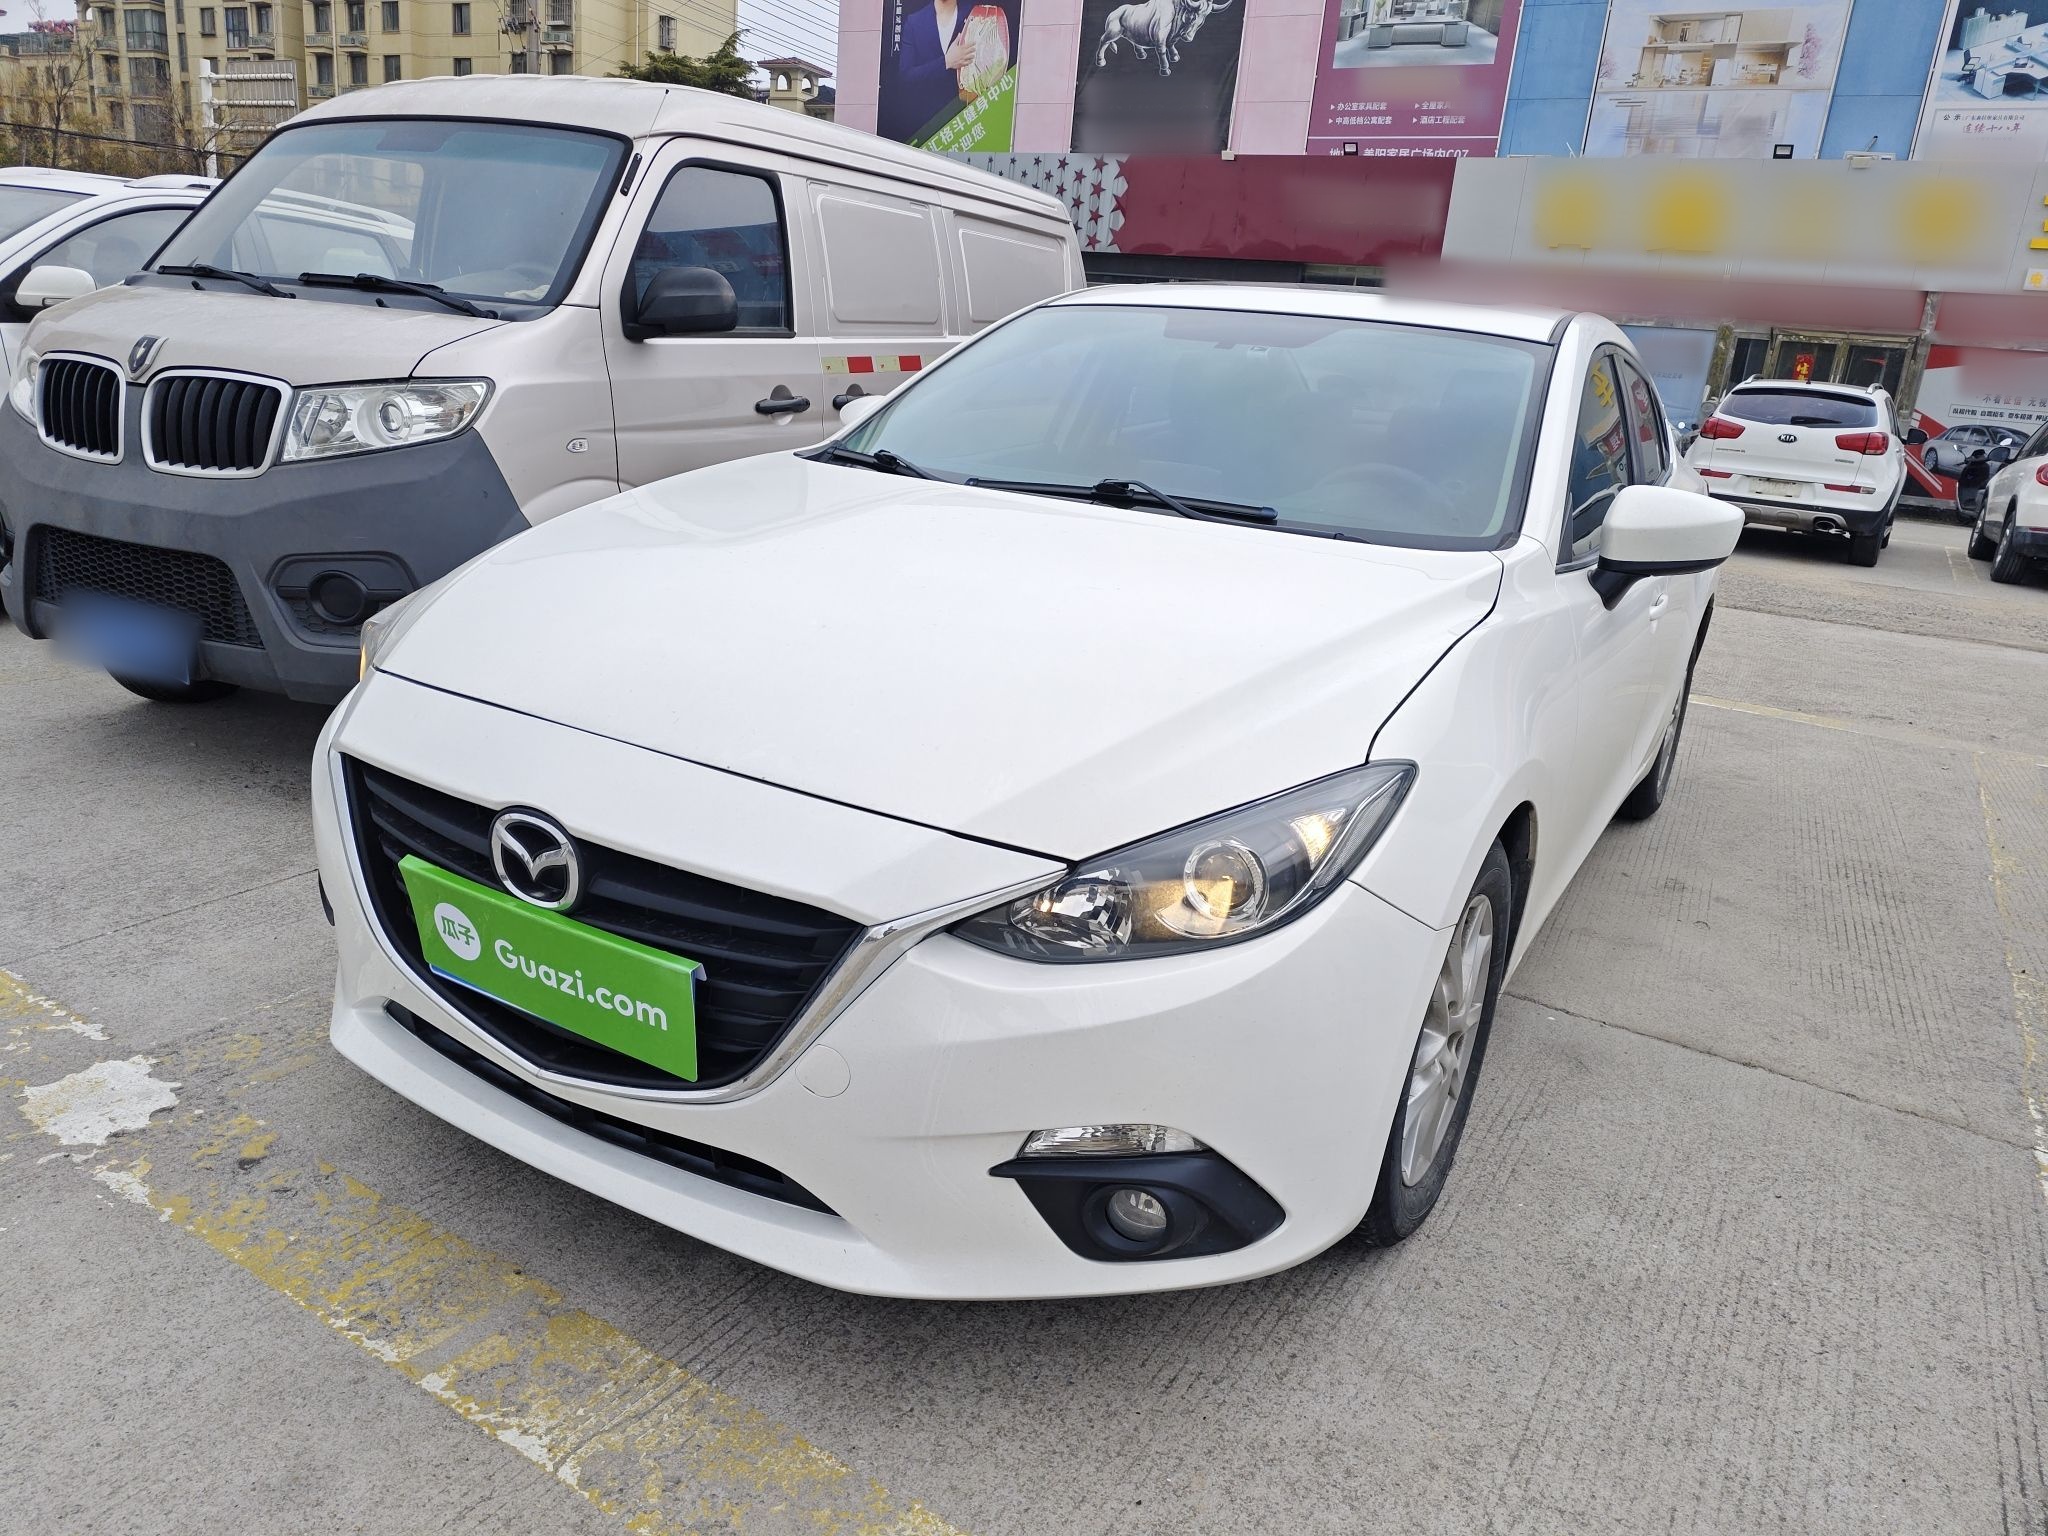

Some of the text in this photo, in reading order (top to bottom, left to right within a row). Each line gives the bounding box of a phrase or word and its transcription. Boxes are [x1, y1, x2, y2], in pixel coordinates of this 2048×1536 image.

[1337, 101, 1388, 111] 办公室家具配套
[922, 74, 1014, 152] 汇格斗健身中心
[1335, 116, 1393, 125] 中高低档公寓配套
[1419, 116, 1466, 124] 酒店工程配套
[1780, 434, 1795, 442] KIA
[440, 915, 475, 946] 瓜子
[494, 939, 668, 1031] Guazi.com
